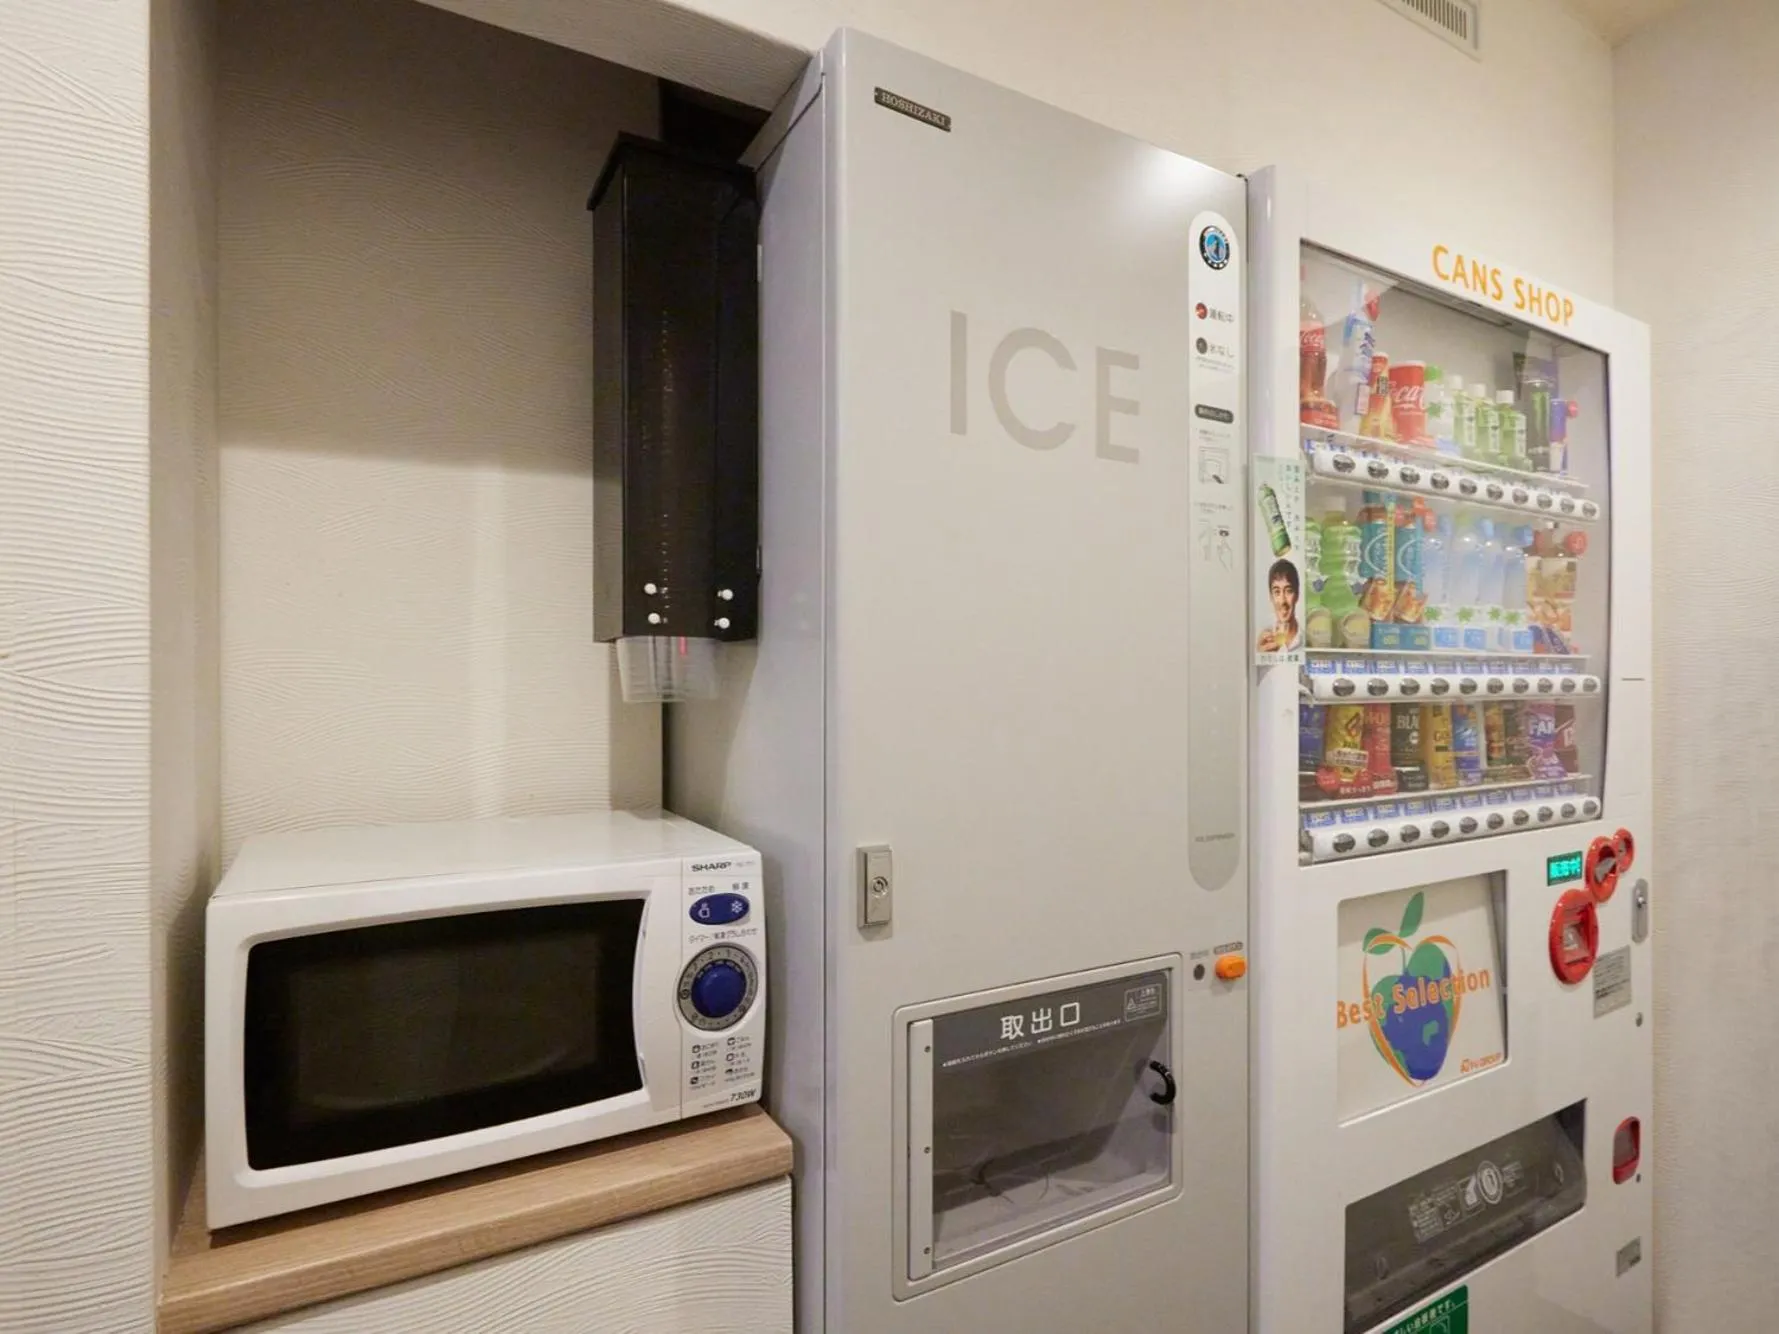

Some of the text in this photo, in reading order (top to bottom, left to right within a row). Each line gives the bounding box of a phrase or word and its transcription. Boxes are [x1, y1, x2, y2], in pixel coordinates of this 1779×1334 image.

[1432, 244, 1575, 327] CANS SHOP
[950, 309, 1140, 464] ICE
[691, 861, 732, 872] SHARP
[1000, 1001, 1081, 1041] 取出口
[1337, 970, 1490, 1029] Best Selection
[730, 1088, 757, 1101] 730W
